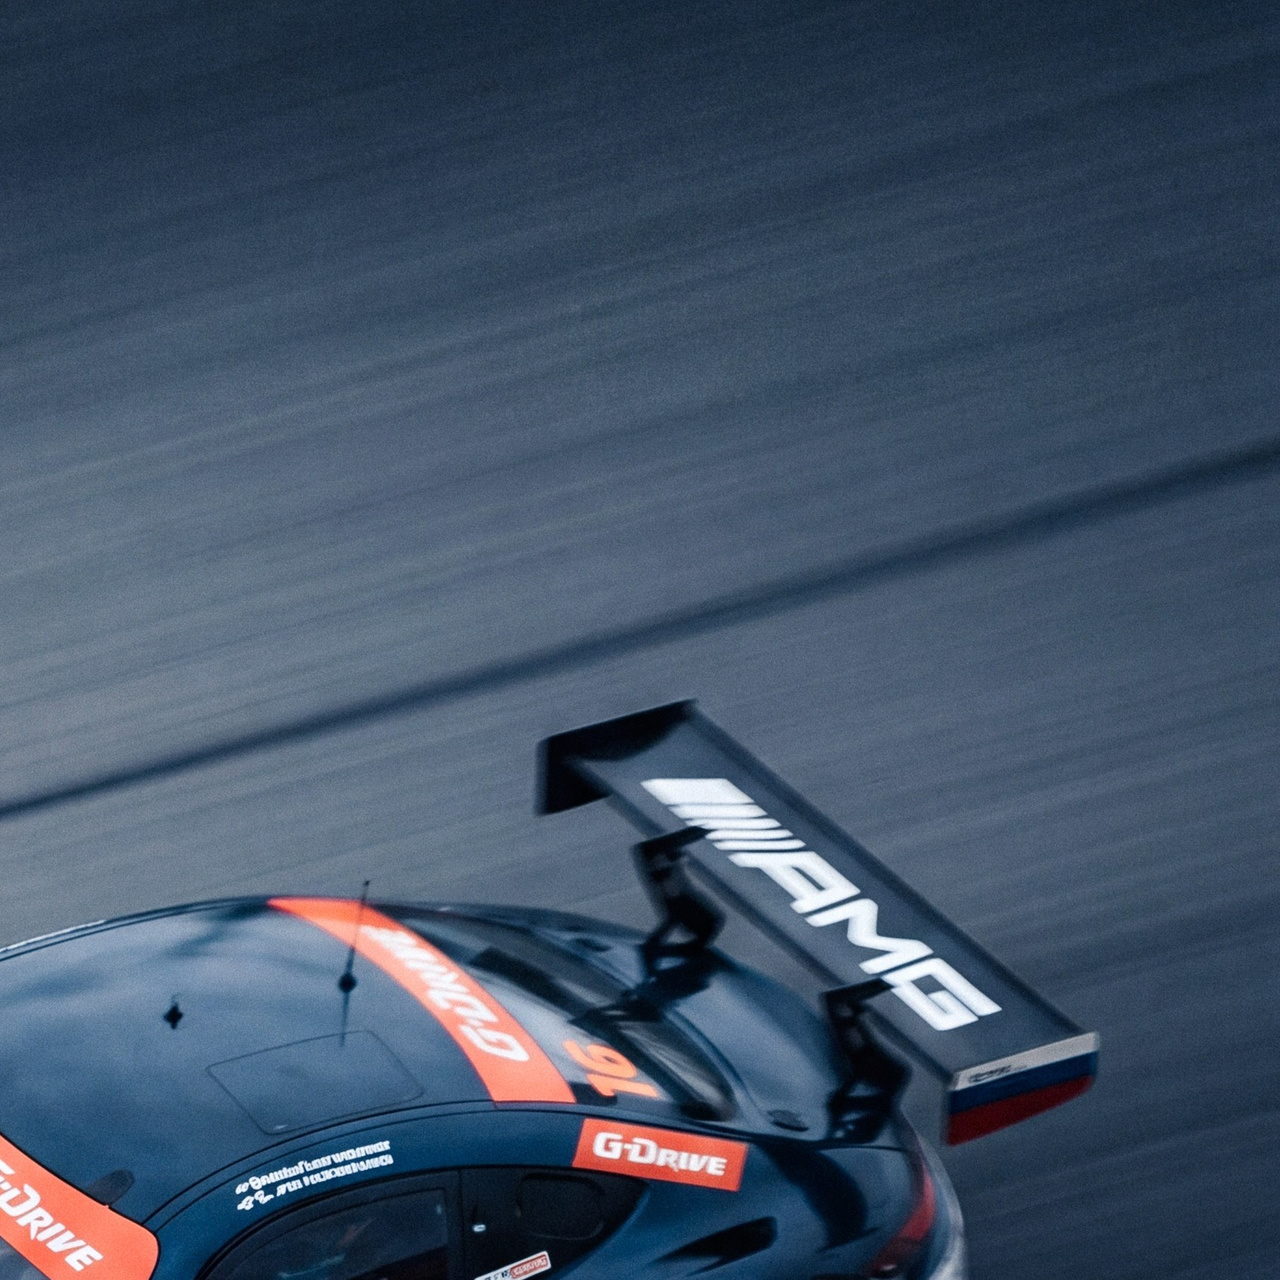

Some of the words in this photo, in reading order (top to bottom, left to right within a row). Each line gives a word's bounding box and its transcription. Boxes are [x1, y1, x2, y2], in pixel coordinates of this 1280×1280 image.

[727, 851, 1002, 1031] AMG
[562, 1040, 659, 1098] 16
[593, 1131, 728, 1176] G-DRIVE
